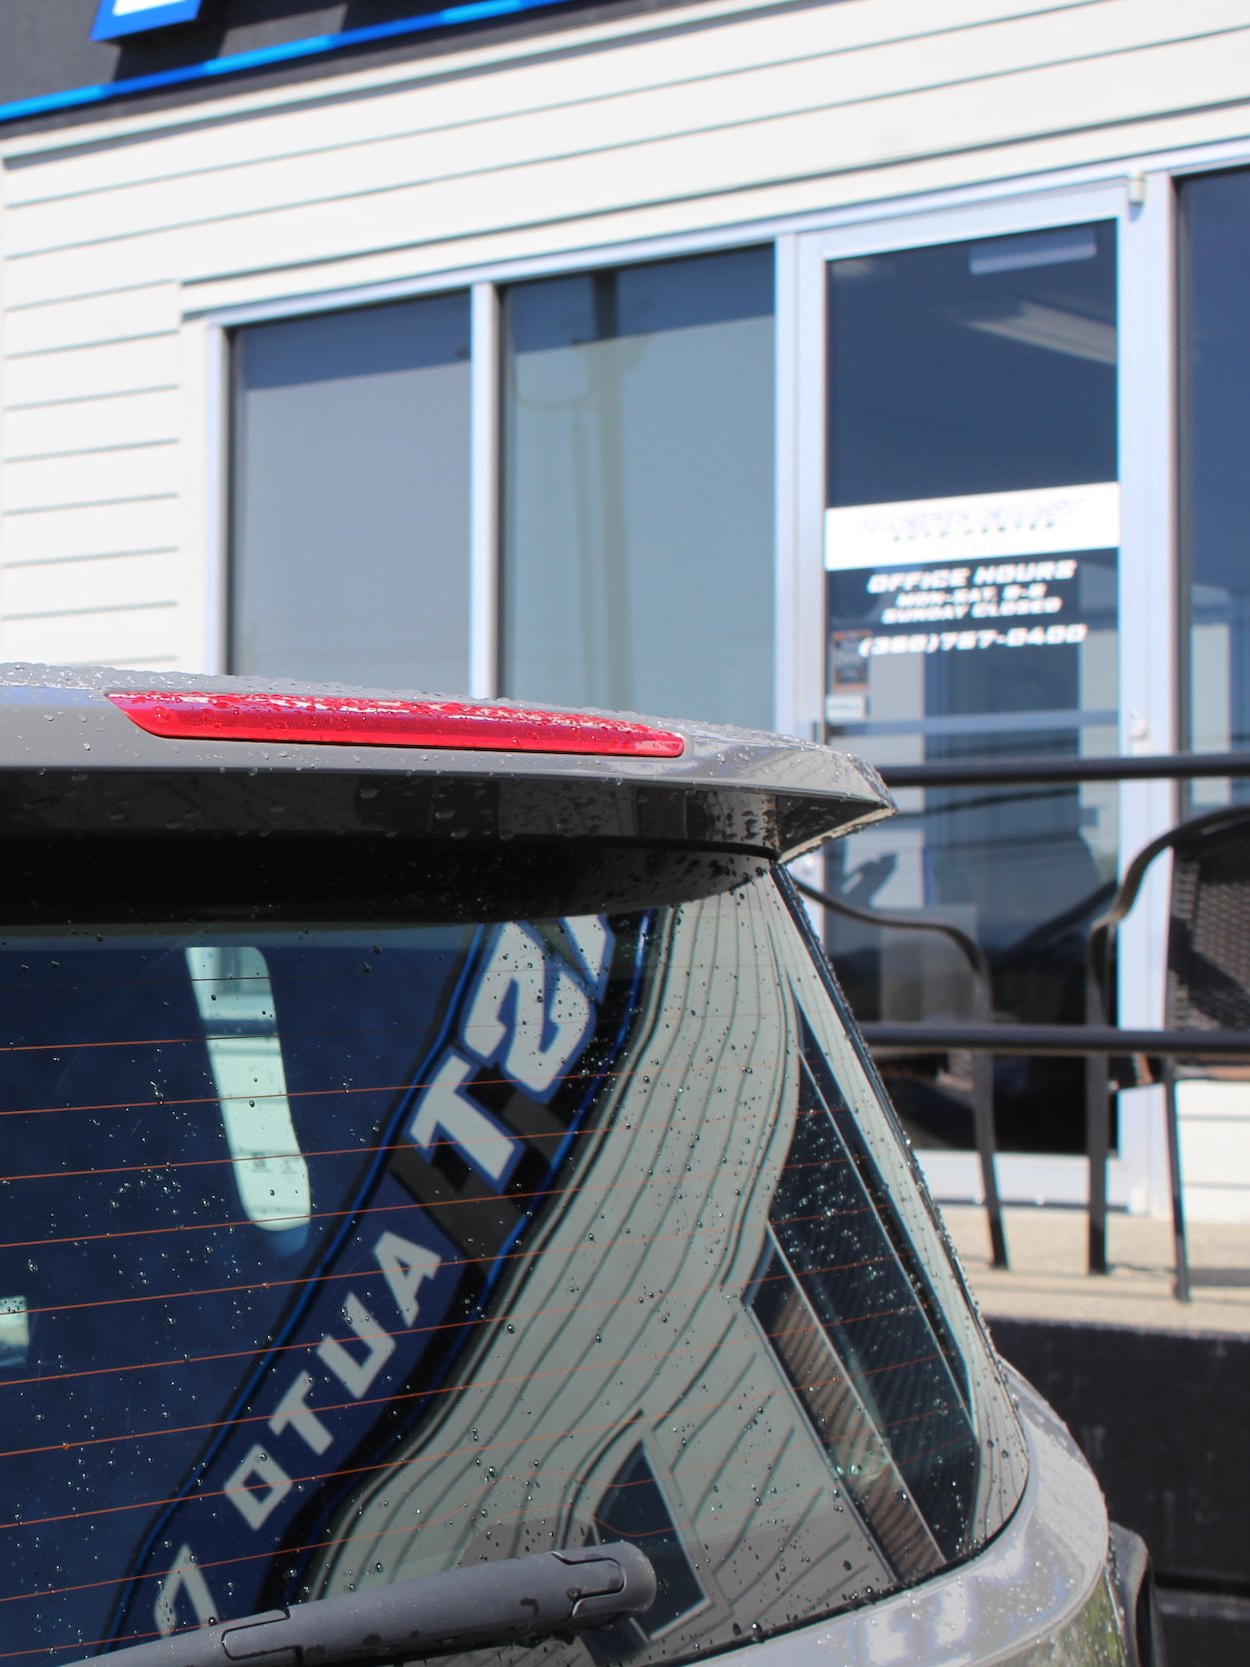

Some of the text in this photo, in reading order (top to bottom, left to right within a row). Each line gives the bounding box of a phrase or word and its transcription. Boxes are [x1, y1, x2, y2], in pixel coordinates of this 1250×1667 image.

[868, 559, 1077, 593] OFFICE HOURS
[882, 597, 1062, 624] SUNDAY CLOSED
